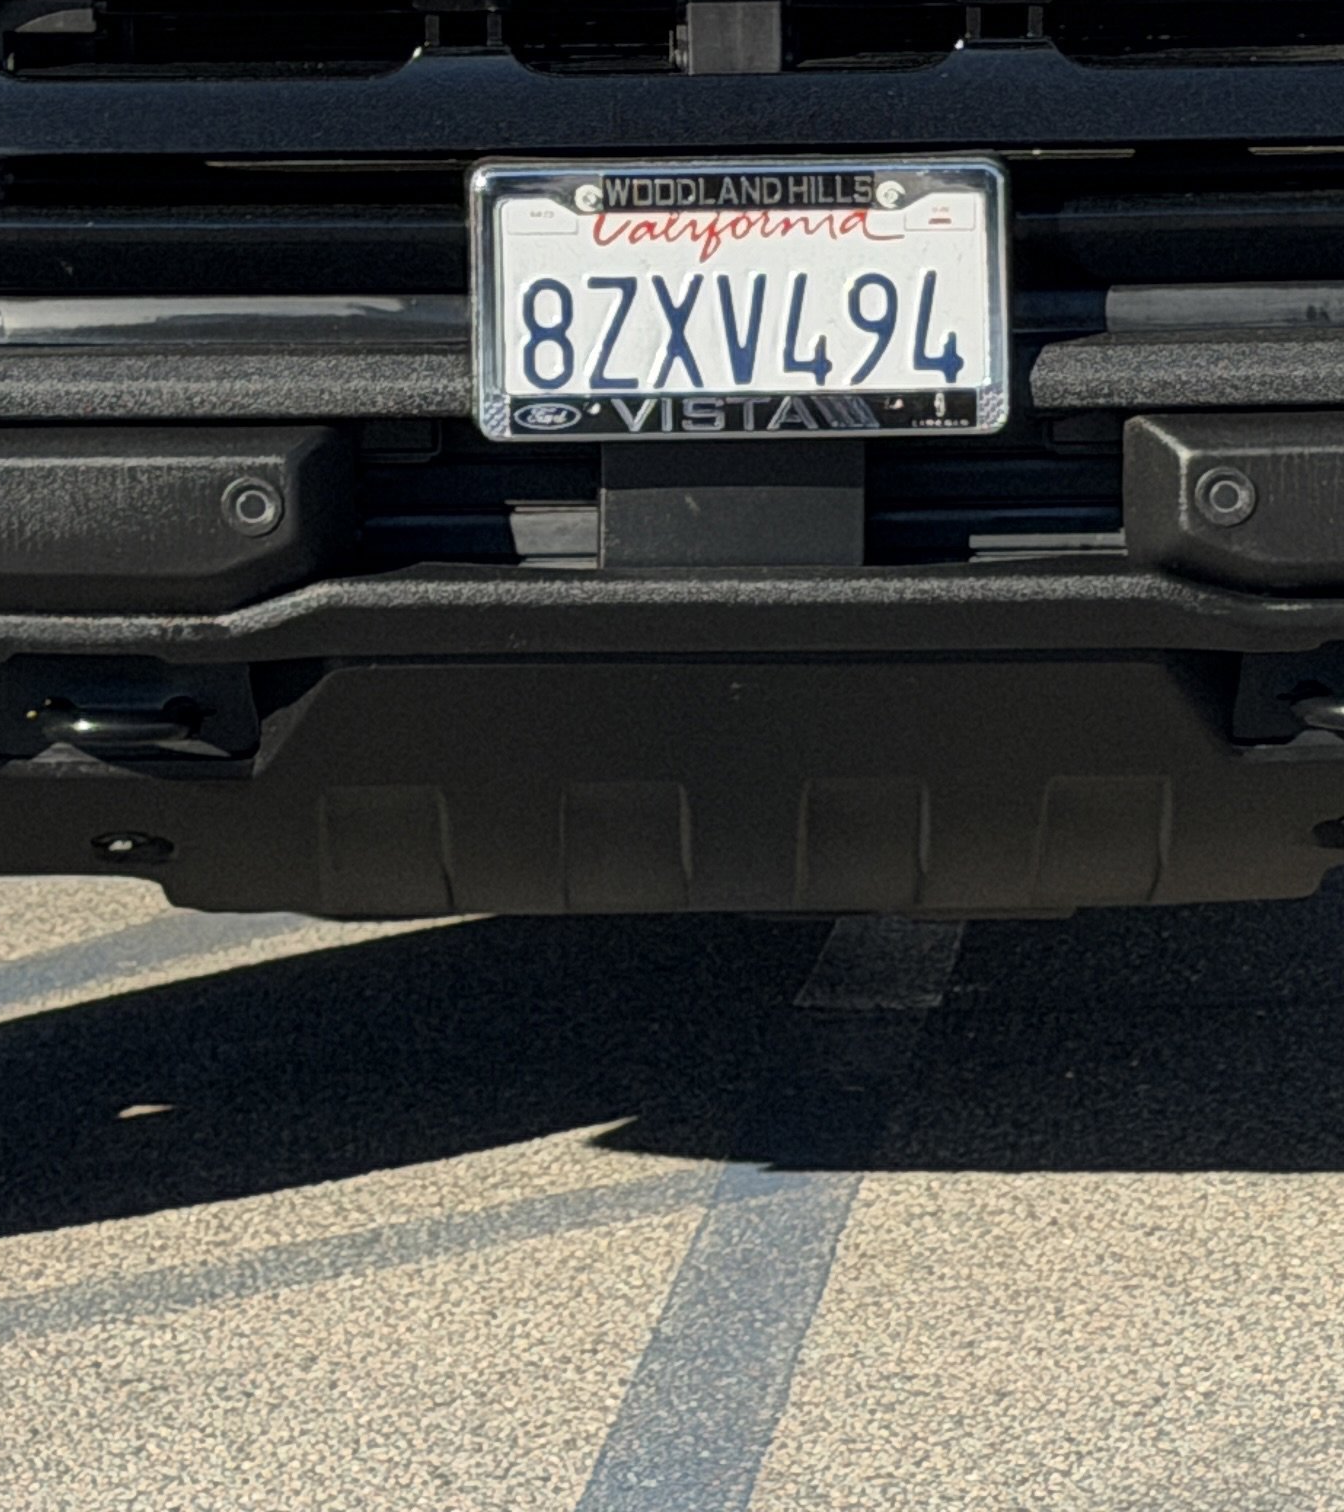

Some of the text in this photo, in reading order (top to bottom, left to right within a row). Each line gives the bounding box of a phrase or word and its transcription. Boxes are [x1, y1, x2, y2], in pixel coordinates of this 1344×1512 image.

[606, 175, 873, 207] WOODLAND HILLS
[522, 270, 965, 390] 8ZXV494
[611, 396, 819, 432] VISTA
